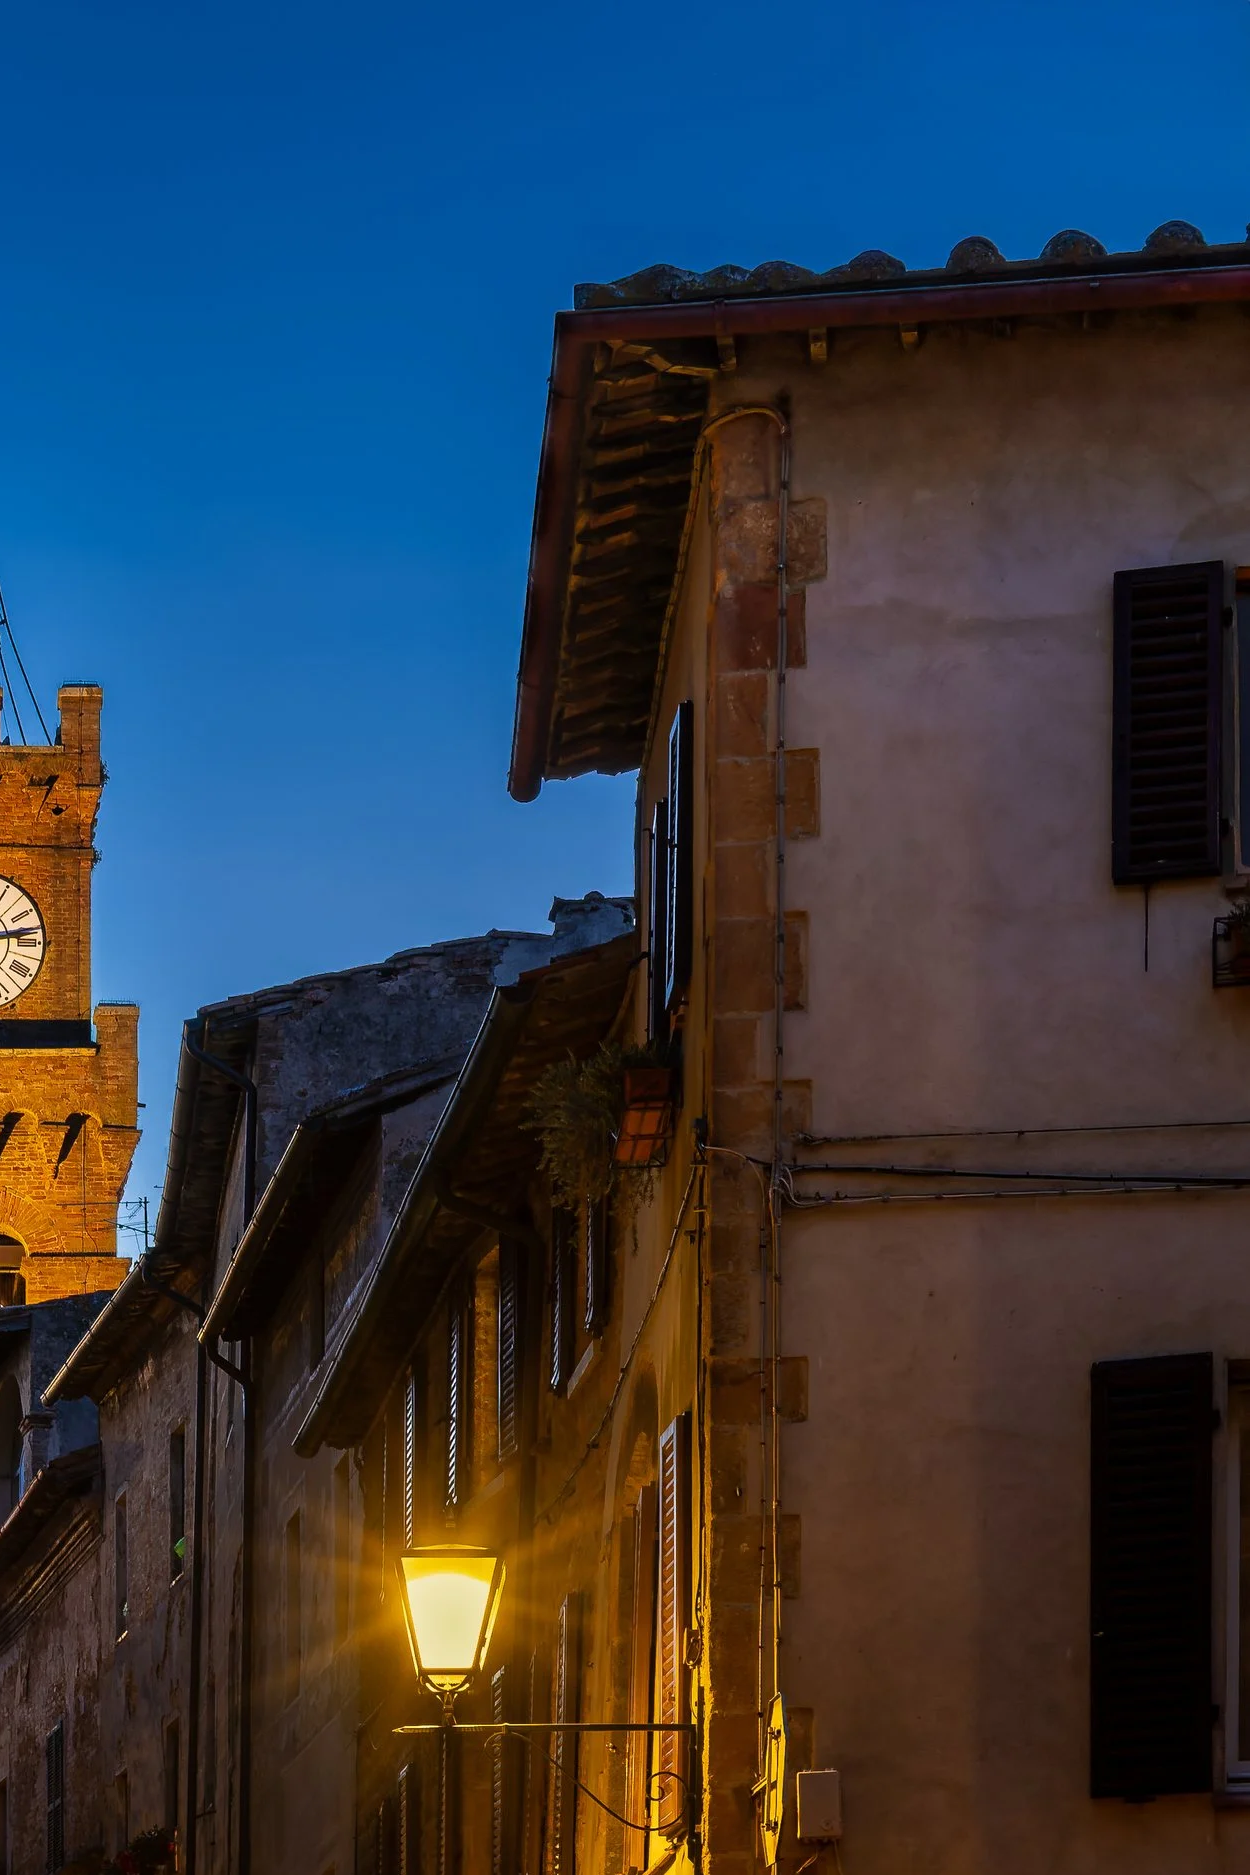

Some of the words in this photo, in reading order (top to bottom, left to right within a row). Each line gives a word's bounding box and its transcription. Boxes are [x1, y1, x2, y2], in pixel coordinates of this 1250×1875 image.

[11, 910, 30, 923] II
[17, 938, 37, 947] III
[8, 959, 31, 978] IIII
